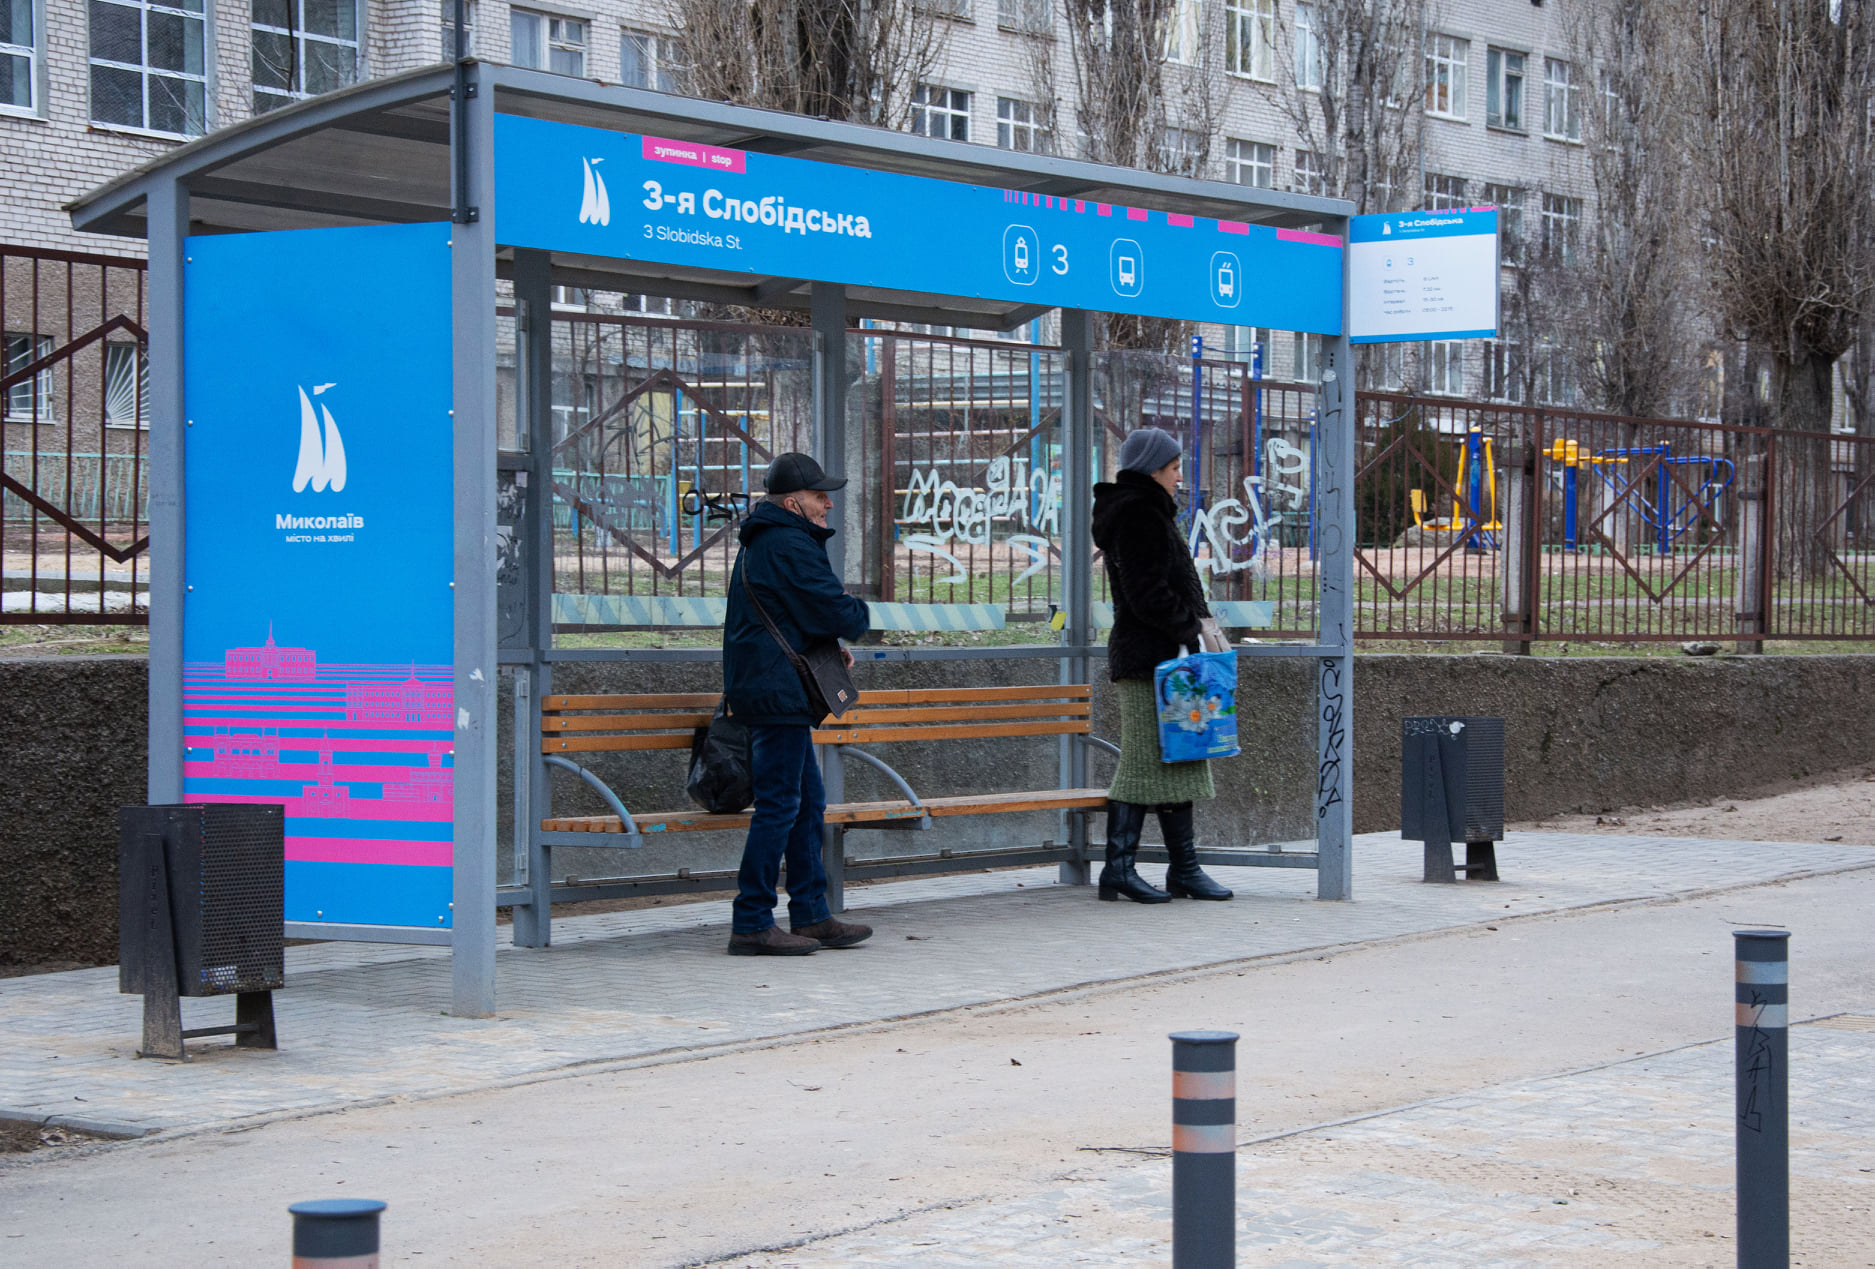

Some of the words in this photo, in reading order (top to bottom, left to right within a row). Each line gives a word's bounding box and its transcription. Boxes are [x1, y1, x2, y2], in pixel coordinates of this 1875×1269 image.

[654, 145, 697, 160] зупинка
[711, 154, 732, 167] stop
[642, 179, 695, 215] 3-я
[702, 188, 872, 239] Слобідська
[1414, 218, 1464, 226] Слобідська
[643, 224, 653, 239] 3
[656, 226, 723, 248] Slobidska
[725, 234, 743, 250] St.
[1052, 244, 1069, 275] 3
[1407, 256, 1415, 266] 3
[276, 513, 364, 529] Миколаїв
[285, 533, 312, 543] місто
[327, 532, 354, 542] хвилі
